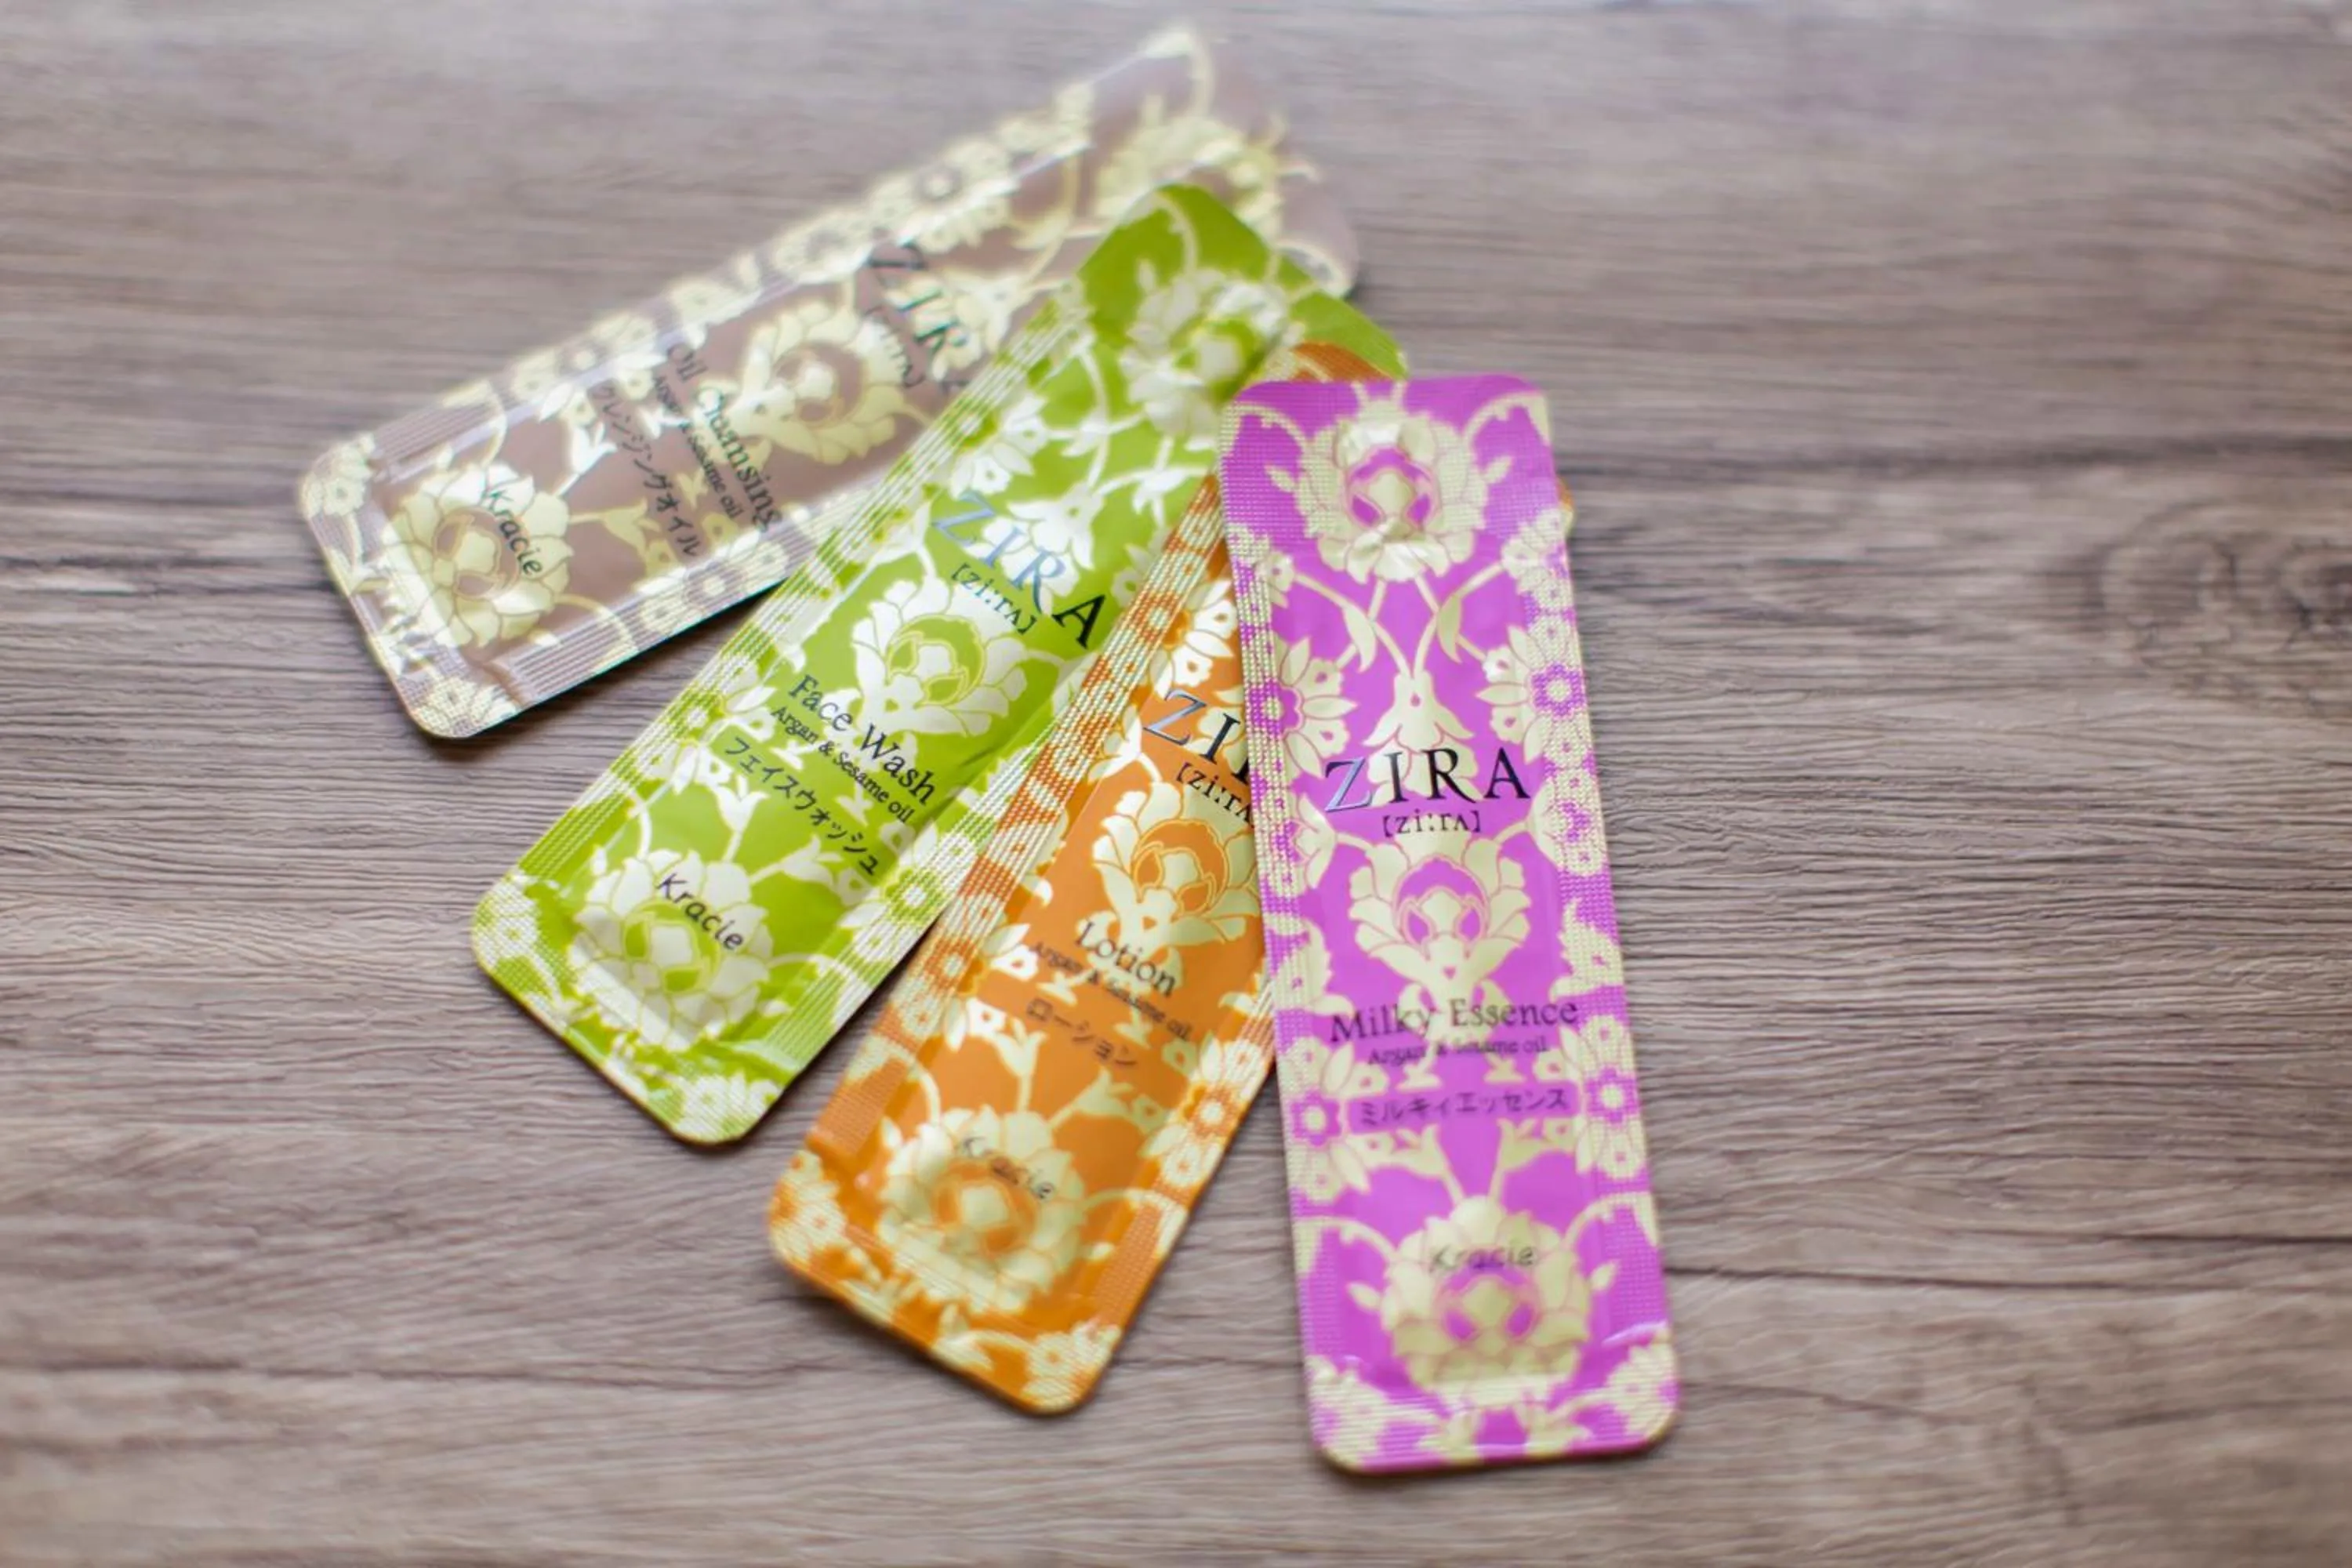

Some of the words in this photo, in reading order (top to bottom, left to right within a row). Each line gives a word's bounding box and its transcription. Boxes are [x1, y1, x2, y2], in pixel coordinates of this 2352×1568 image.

[698, 387, 783, 532] Cleansing
[480, 488, 543, 575] Kracie
[931, 490, 1106, 650] ZIRA
[771, 706, 820, 745] Argan
[818, 742, 834, 757] &
[833, 751, 890, 804] Sesame
[887, 800, 916, 823] oil
[788, 674, 854, 732] Face
[859, 723, 936, 807] Wash
[1142, 688, 1249, 786] ZI
[725, 737, 880, 877] フェイスウォッシュ
[1324, 746, 1531, 814] ZIRA
[656, 872, 744, 950] Kracie
[1075, 920, 1176, 997] Lotion
[1026, 997, 1138, 1066] ローション
[1330, 1002, 1432, 1043] Milky
[1446, 997, 1579, 1028] Essence
[1523, 1036, 1550, 1054] oil
[1360, 1088, 1569, 1127] ミルキィエッセンス
